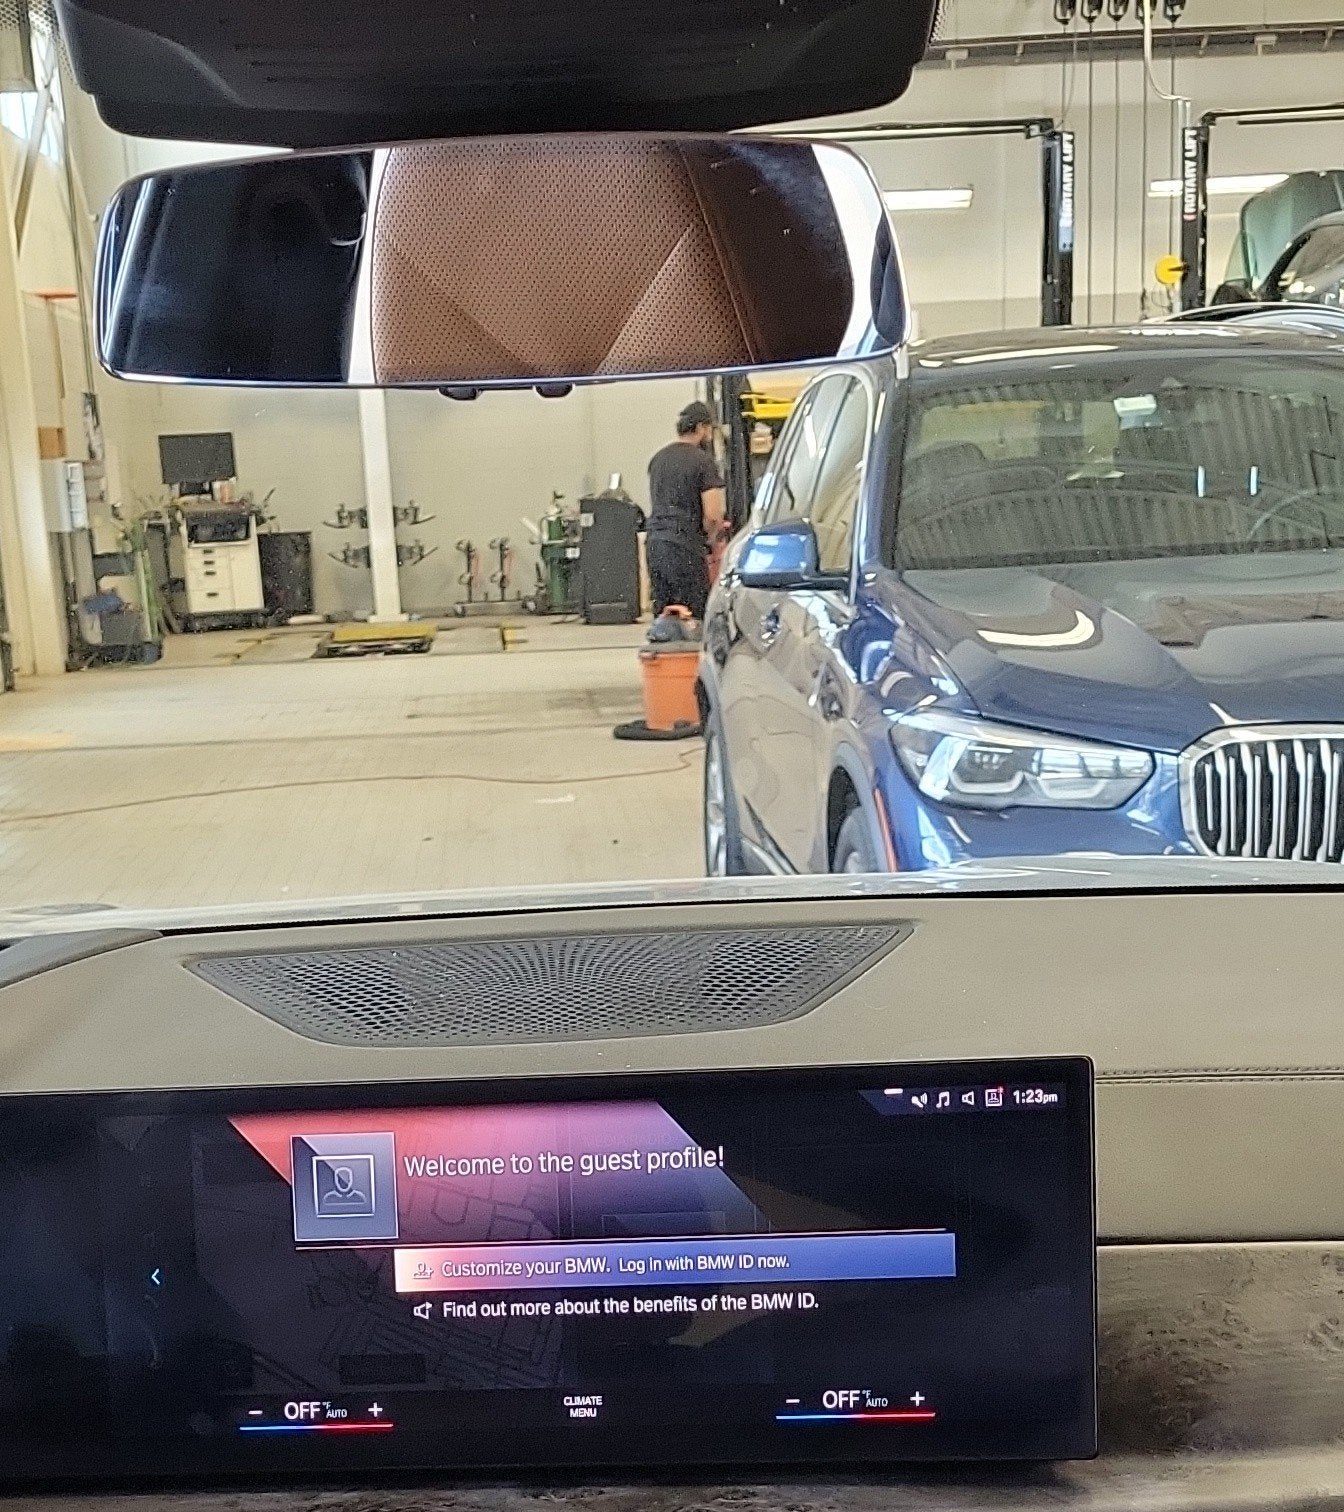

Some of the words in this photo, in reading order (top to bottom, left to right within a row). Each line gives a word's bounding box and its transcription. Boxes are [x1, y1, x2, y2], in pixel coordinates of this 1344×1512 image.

[403, 1154, 504, 1177] Welcome
[510, 1155, 533, 1174] to
[538, 1152, 574, 1173] the
[580, 1149, 641, 1176] guest
[647, 1145, 724, 1173] profile!
[441, 1260, 522, 1277] Customize
[525, 1261, 562, 1278] your
[565, 1256, 611, 1274] BMW.
[619, 1257, 645, 1275] Log
[665, 1255, 694, 1271] with
[697, 1254, 735, 1270] BMW
[738, 1254, 754, 1269] ID
[757, 1255, 790, 1268] now.
[443, 1301, 477, 1318] Find
[480, 1301, 507, 1317] out
[510, 1303, 551, 1316] more
[554, 1298, 601, 1315] about
[603, 1297, 629, 1314] the
[633, 1296, 698, 1313] benefits
[701, 1294, 719, 1312] of
[721, 1294, 747, 1311] the
[751, 1293, 793, 1310] BMW
[797, 1292, 819, 1309] ID.
[563, 1395, 603, 1406] CLIMATE
[822, 1389, 861, 1409] OFF
[865, 1397, 888, 1408] AUTO
[284, 1401, 321, 1420] OFF
[325, 1408, 348, 1418] AUTO
[569, 1407, 598, 1418] MENU
